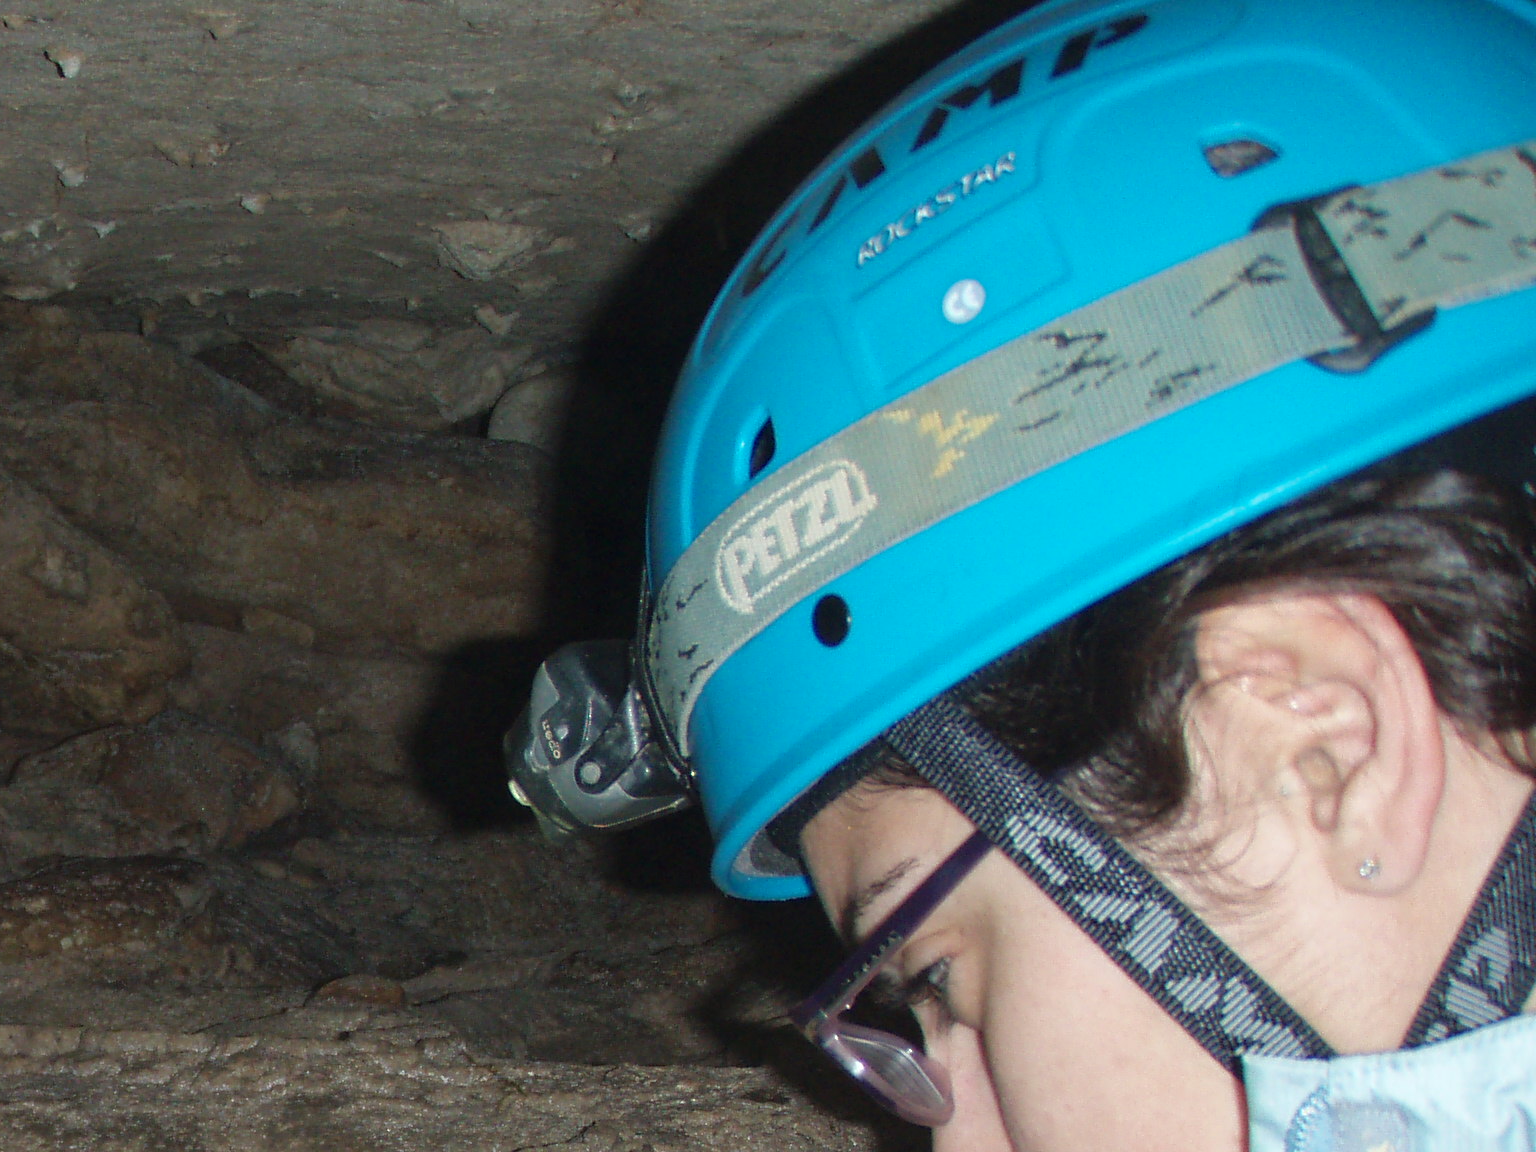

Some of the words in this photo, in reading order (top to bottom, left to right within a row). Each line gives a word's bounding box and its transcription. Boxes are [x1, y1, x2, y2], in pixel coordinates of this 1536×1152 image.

[742, 14, 1150, 297] CAMP
[855, 151, 1016, 268] ROCKSTAR
[722, 468, 878, 614] PETZL
